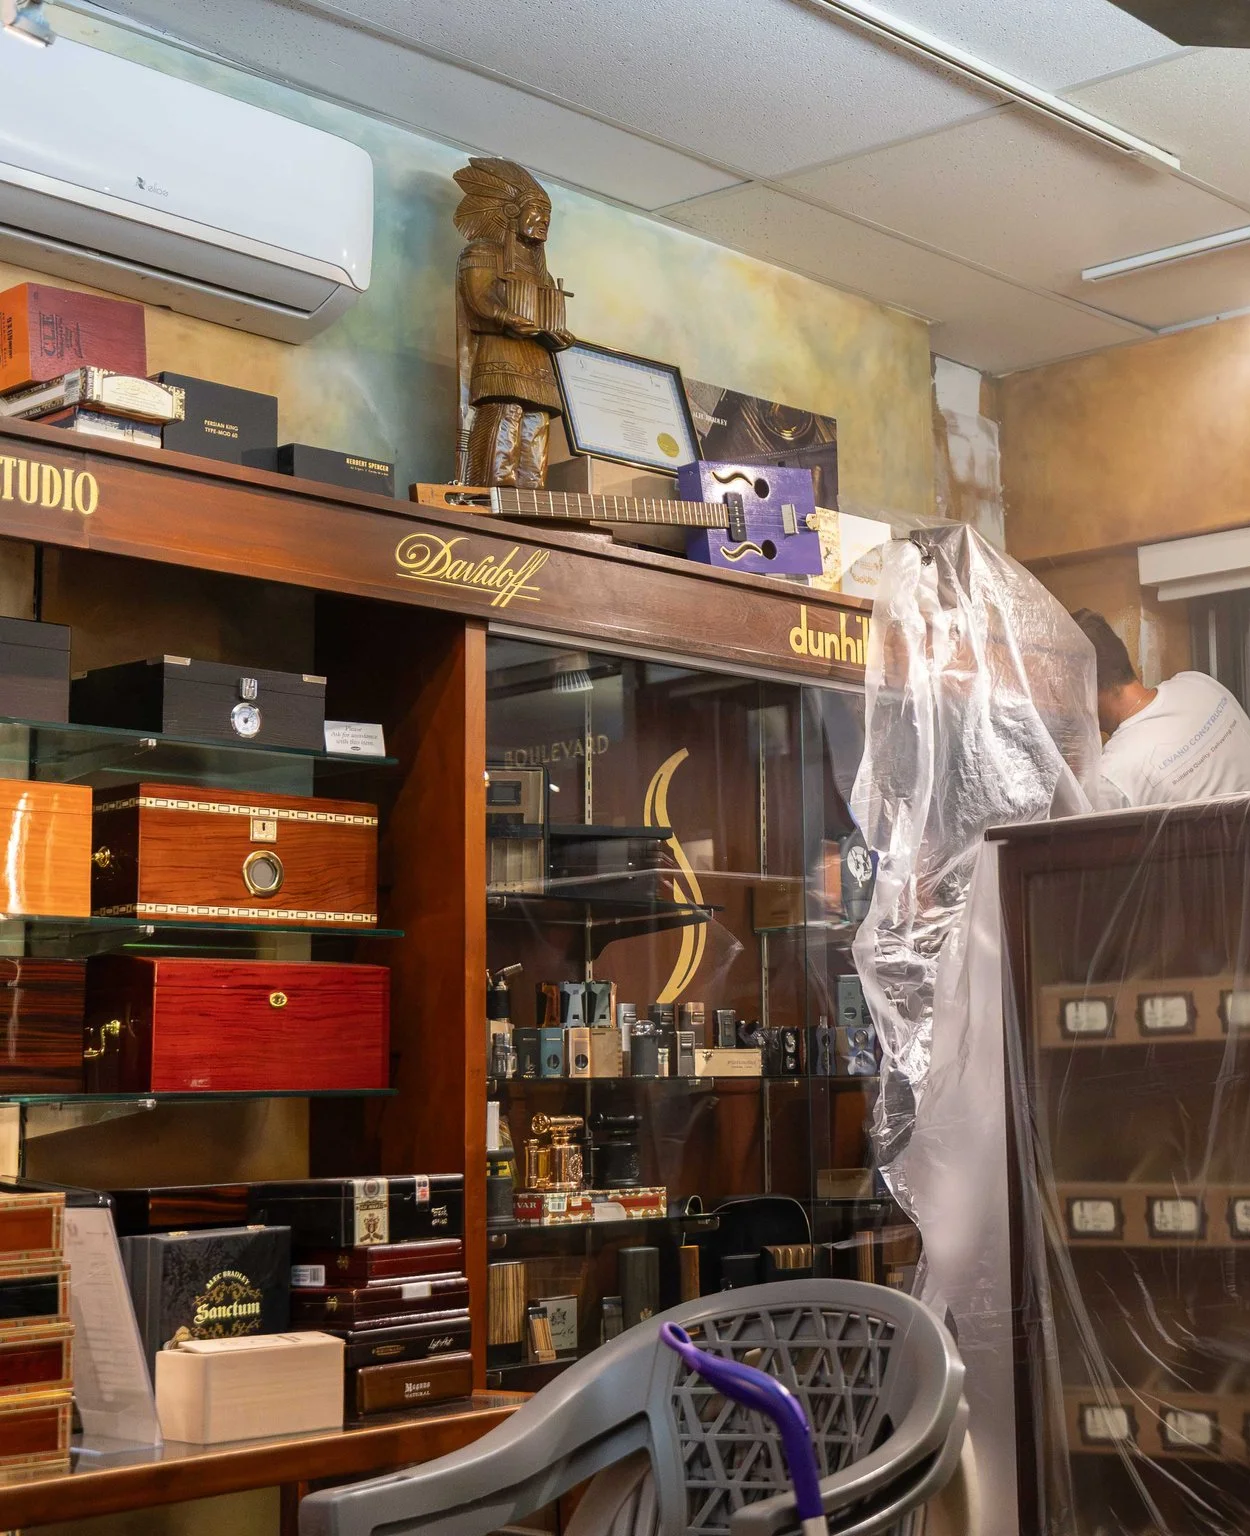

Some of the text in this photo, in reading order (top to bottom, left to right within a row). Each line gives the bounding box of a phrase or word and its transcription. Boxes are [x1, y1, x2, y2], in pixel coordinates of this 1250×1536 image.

[346, 457, 368, 468] HERBERT
[368, 462, 389, 472] SPENCER
[0, 456, 99, 515] TUDIO
[395, 533, 550, 608] Davidoff
[789, 604, 872, 665] dunhil
[206, 1269, 250, 1289] ALEC BRADLEY
[194, 1301, 261, 1324] Sanctum
